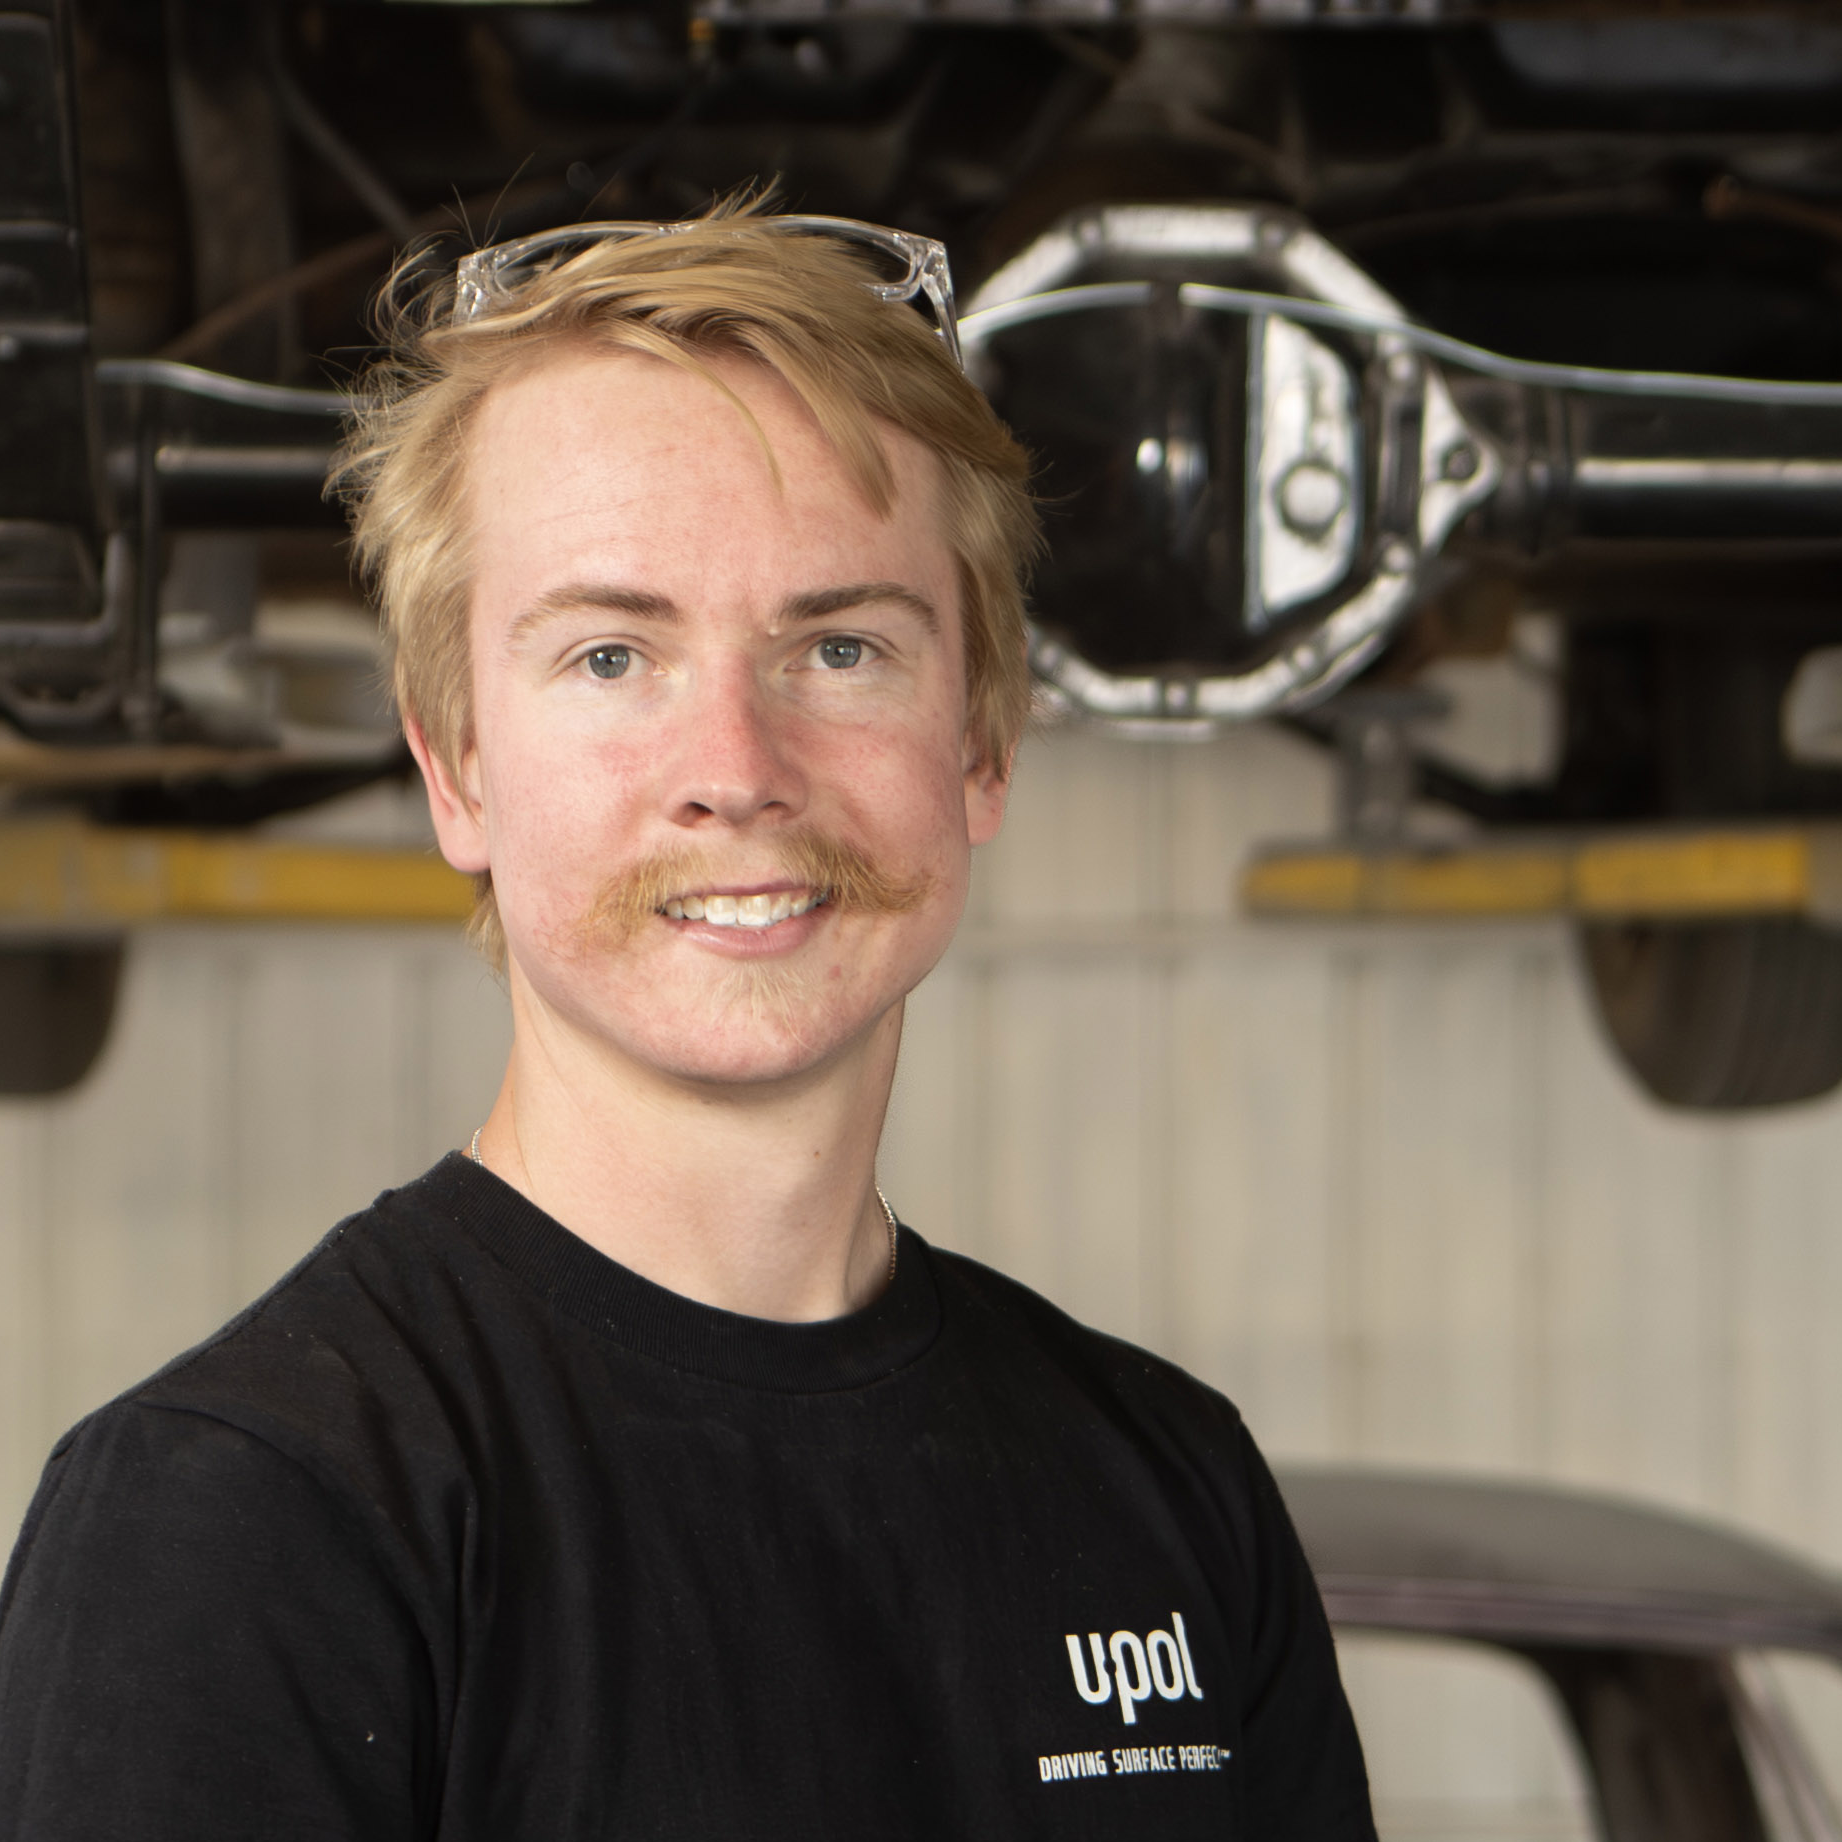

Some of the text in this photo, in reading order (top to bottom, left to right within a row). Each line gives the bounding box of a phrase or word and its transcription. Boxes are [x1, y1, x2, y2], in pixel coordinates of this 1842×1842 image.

[1065, 1611, 1204, 1725] upol
[1038, 1744, 1223, 1783] DRIVING SURFACE PERFEC
